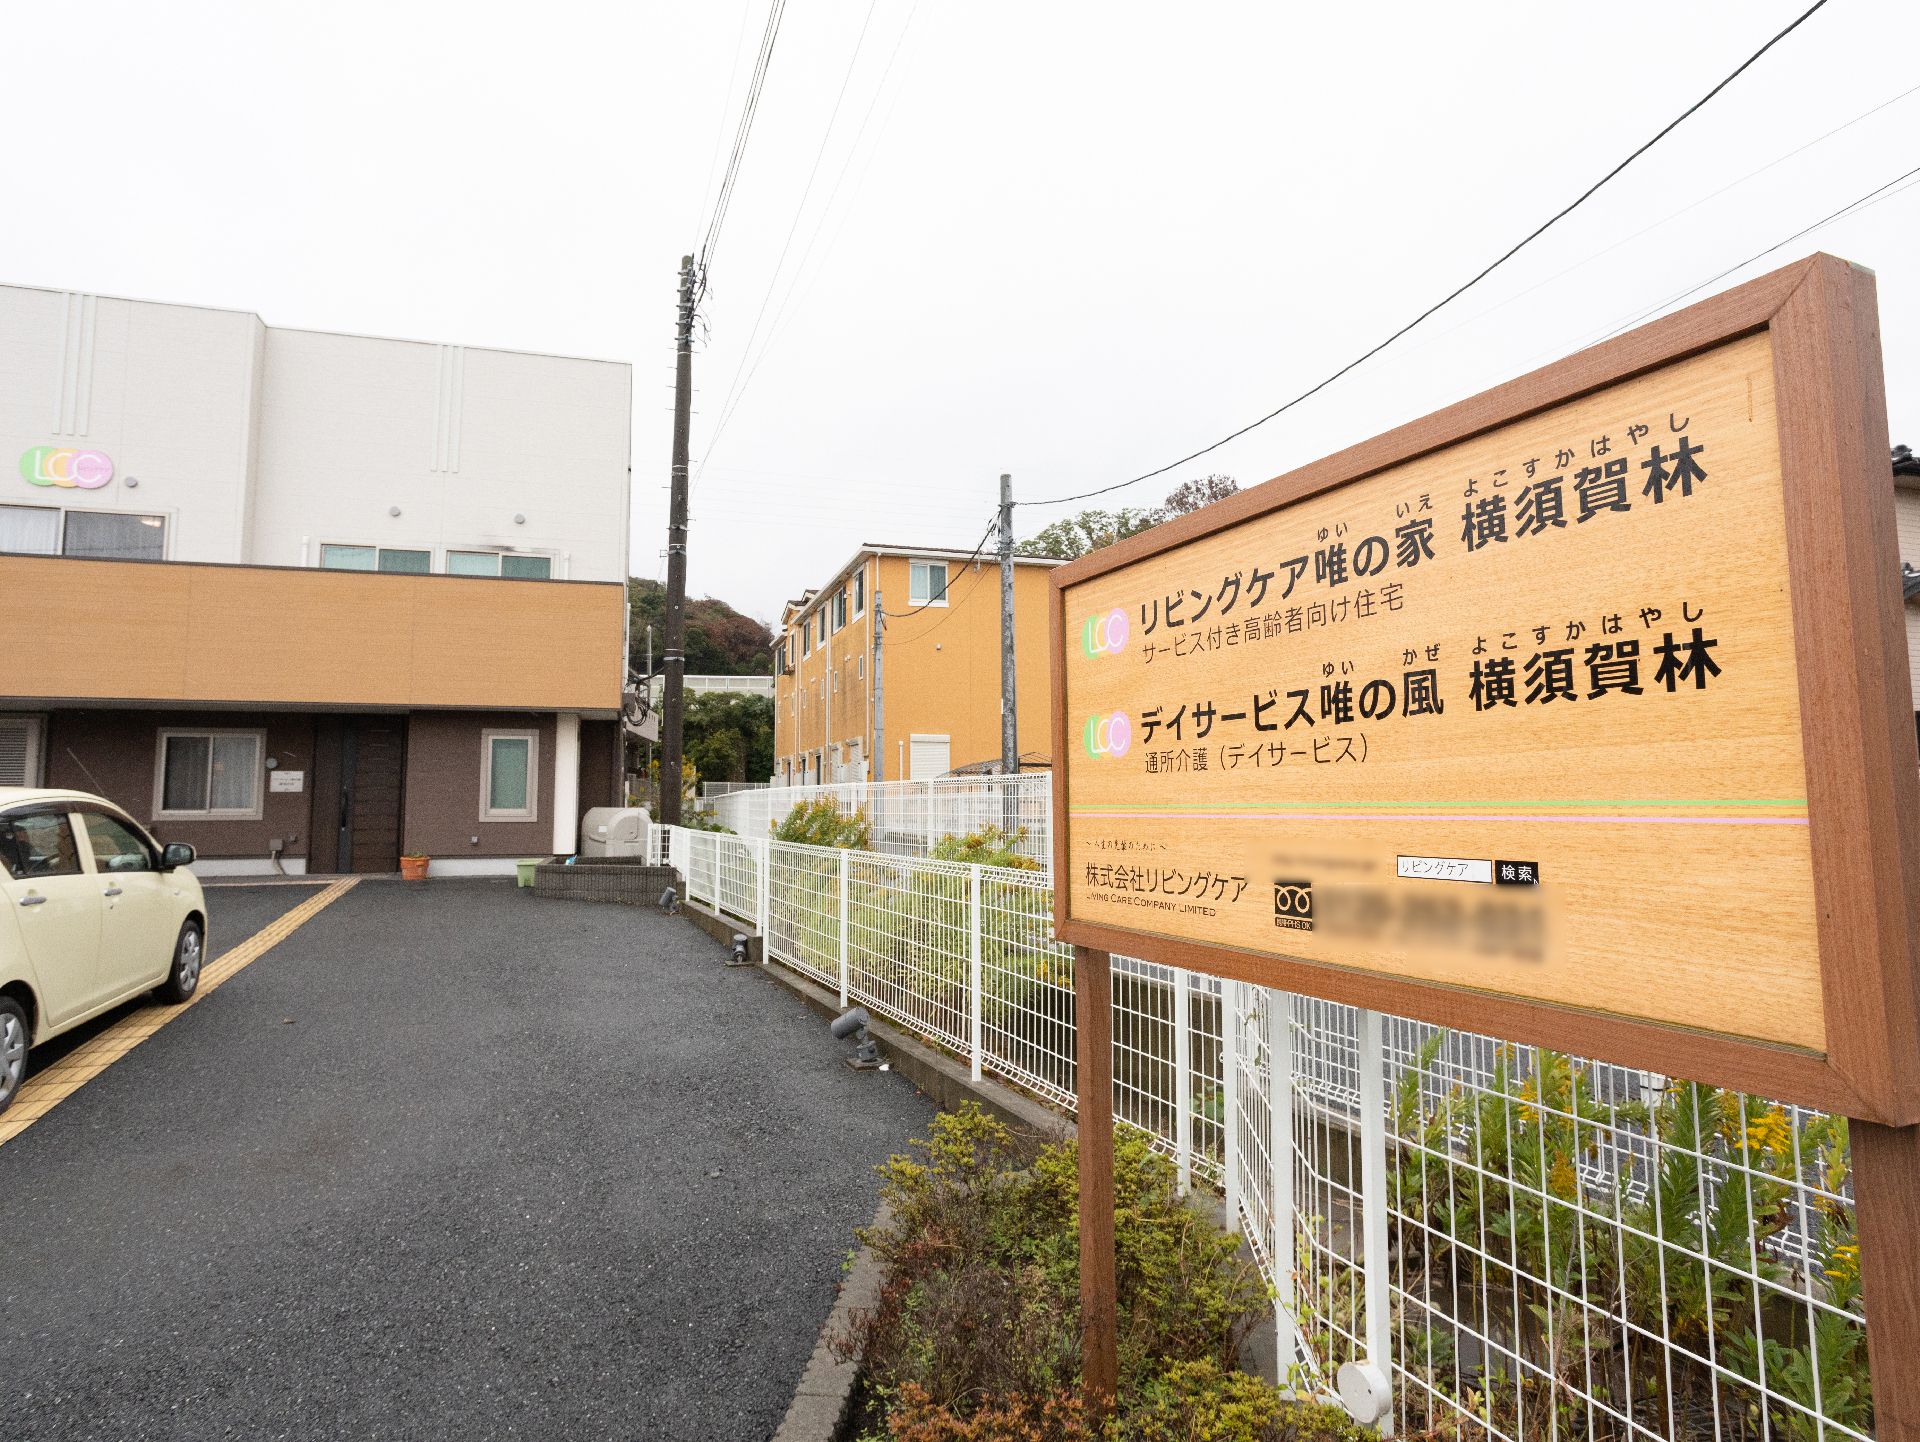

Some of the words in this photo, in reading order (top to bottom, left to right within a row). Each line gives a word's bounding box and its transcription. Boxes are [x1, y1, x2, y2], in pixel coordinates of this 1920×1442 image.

[1140, 517, 1436, 636] リビングケア唯の家
[1461, 436, 1708, 552] 横須賀林
[1317, 522, 1348, 543] ゆい
[1396, 493, 1433, 519] いえ
[1143, 582, 1404, 664] サービス付き高齢者向け住宅
[1322, 660, 1355, 677] ゆい
[1402, 643, 1441, 666] かぜ
[1141, 668, 1444, 744] デイサービス唯の風
[1468, 627, 1722, 711] 横須賀林
[1085, 861, 1248, 903] 株式会社リビングケア
[1501, 864, 1532, 881] 検索
[1110, 893, 1133, 905] CARE
[1134, 896, 1177, 912] COMPANY
[1179, 903, 1217, 917] LIMITED
